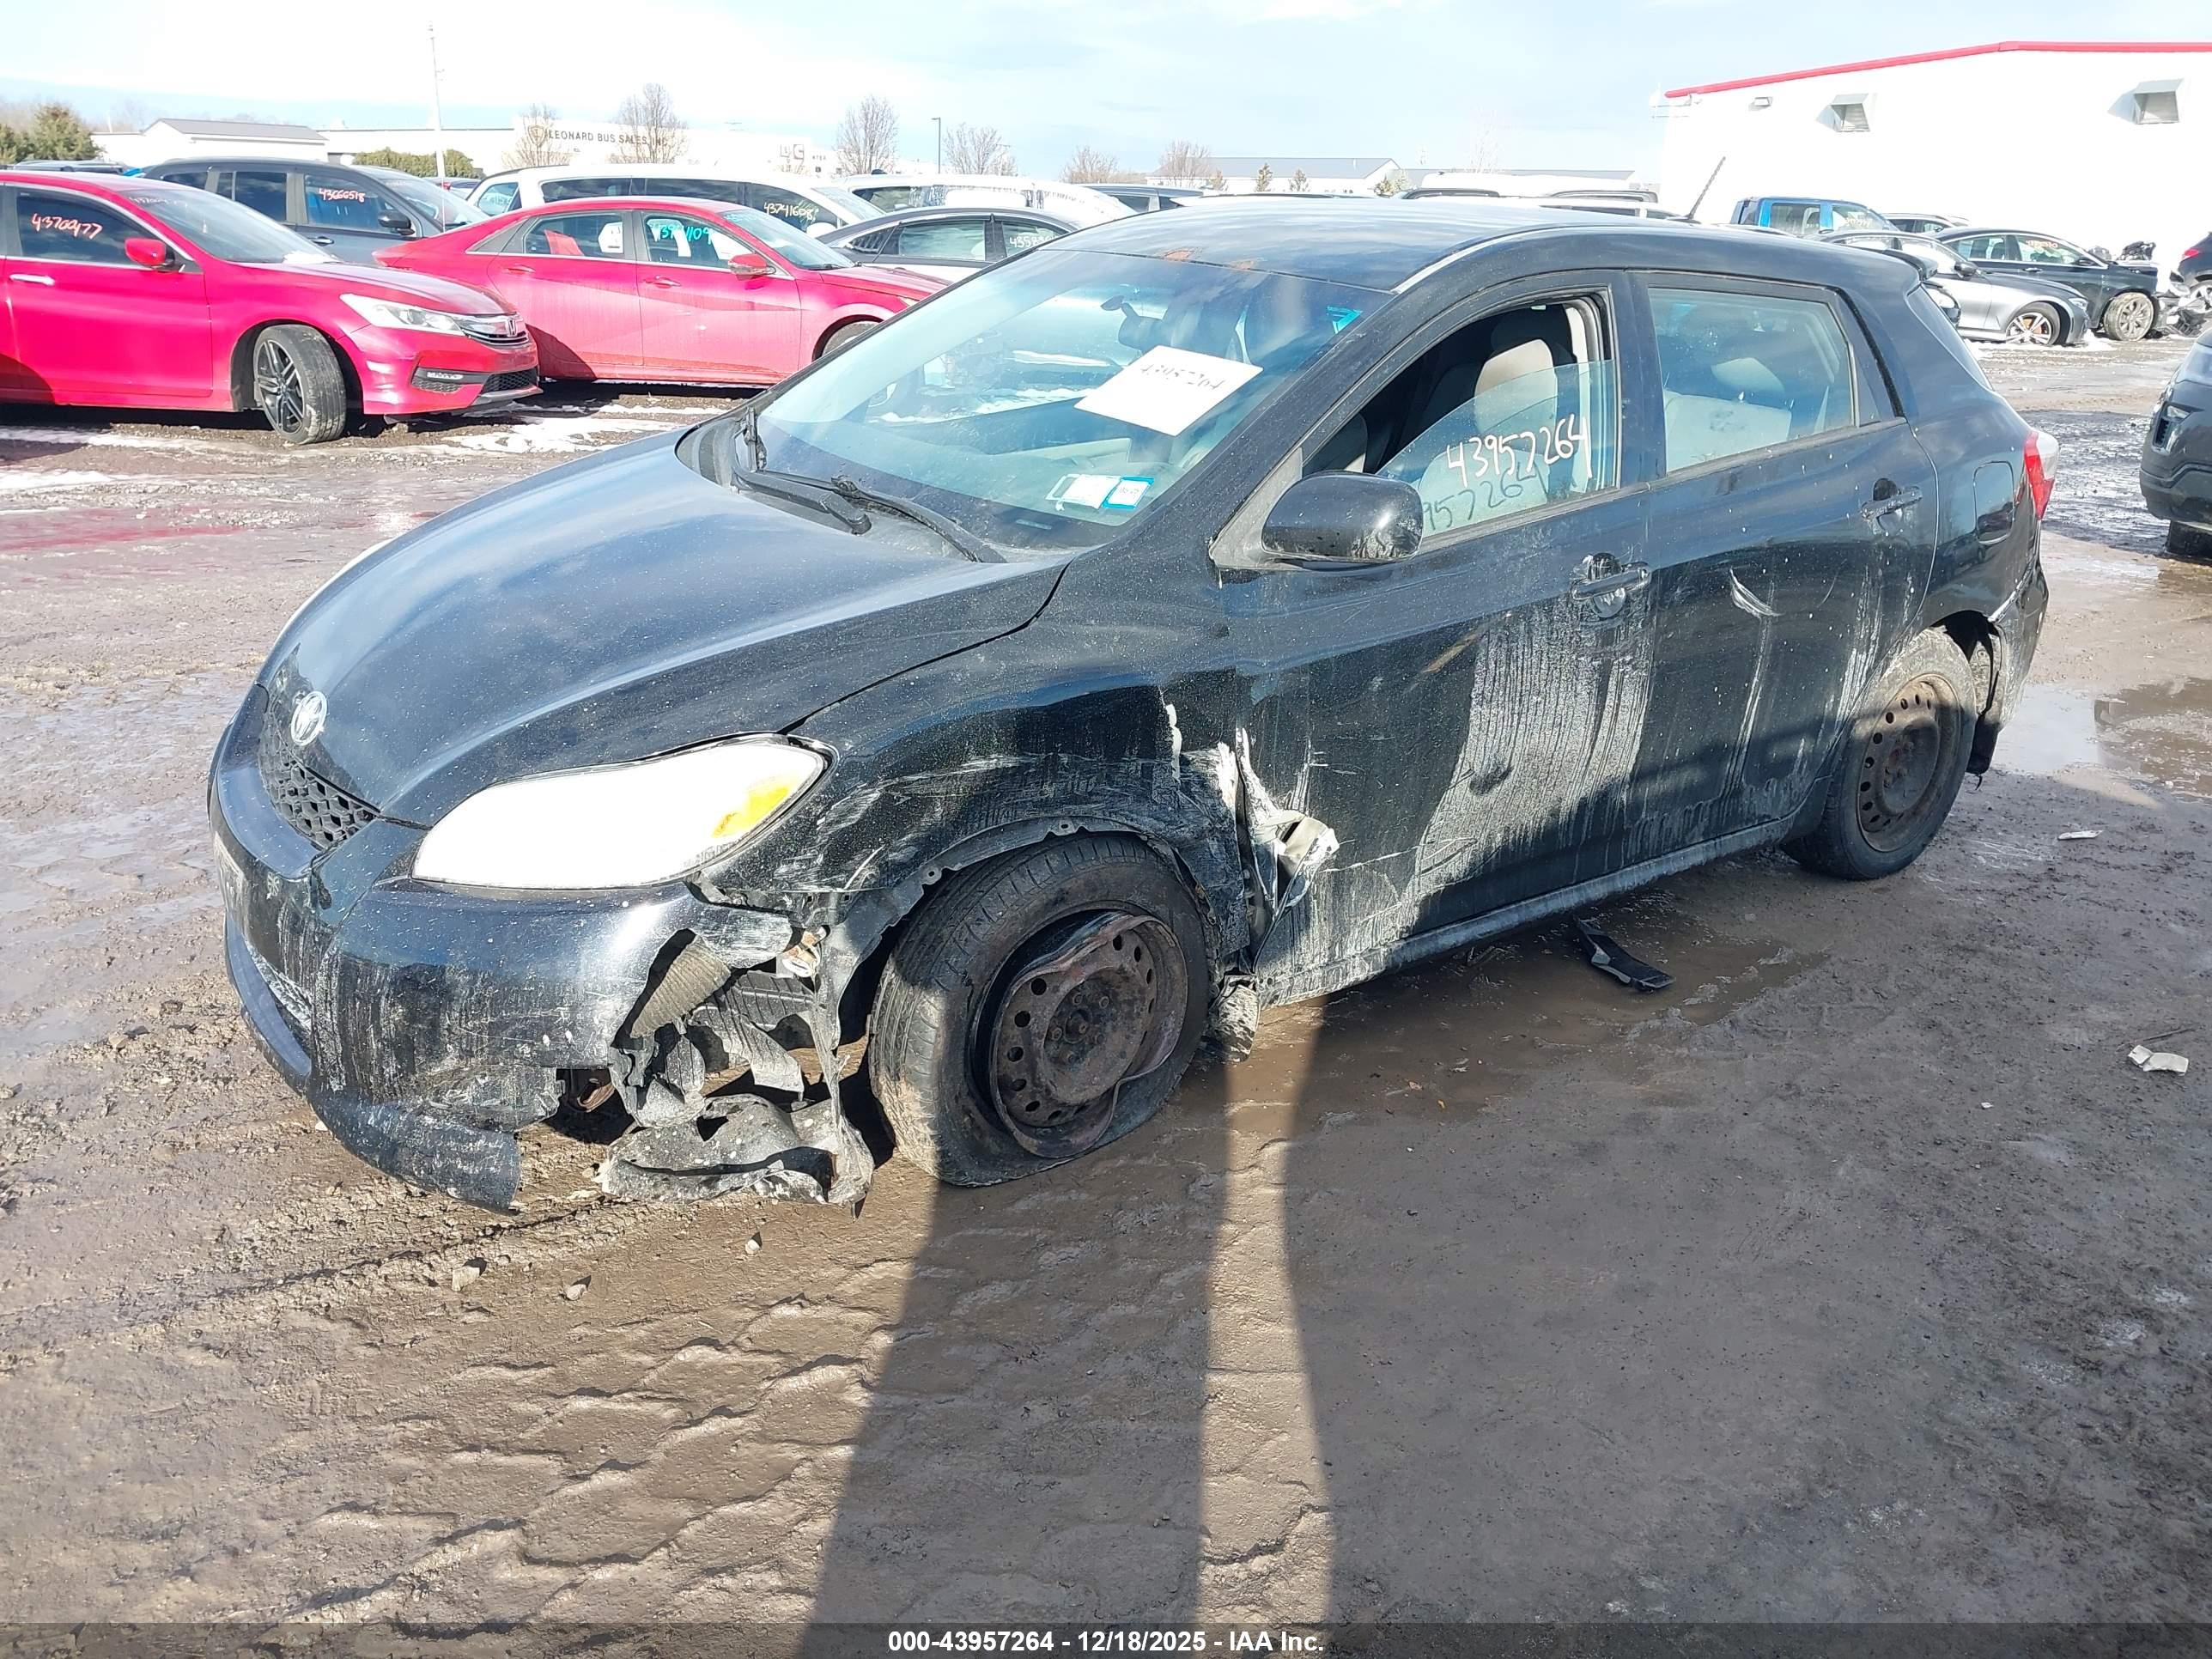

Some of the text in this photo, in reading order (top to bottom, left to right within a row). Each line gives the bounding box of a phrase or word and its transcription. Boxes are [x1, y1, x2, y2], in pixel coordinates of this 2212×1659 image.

[548, 130, 594, 141] LEONARD
[597, 133, 616, 143] BUS
[1447, 413, 1592, 488] 43957264
